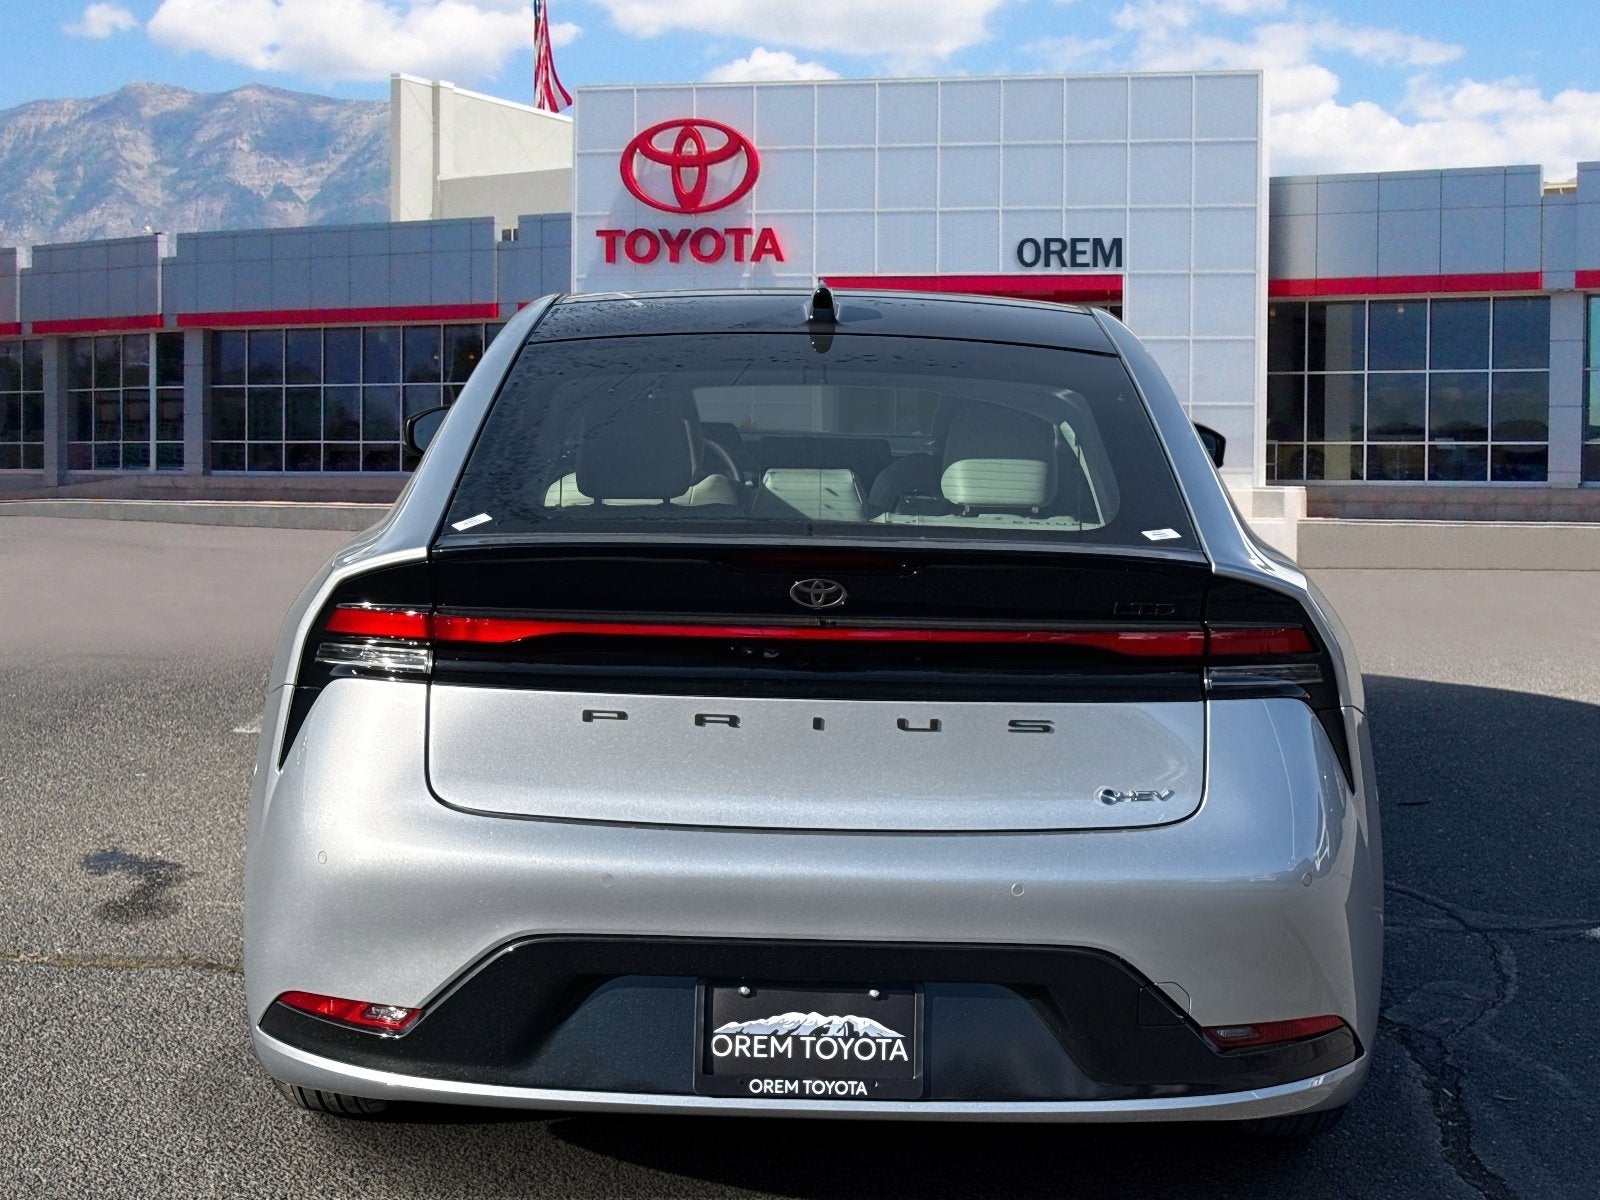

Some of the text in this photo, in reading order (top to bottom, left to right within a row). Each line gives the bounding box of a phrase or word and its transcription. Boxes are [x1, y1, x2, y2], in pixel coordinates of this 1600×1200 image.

[595, 227, 785, 264] TOYOTA
[1016, 237, 1123, 268] OREM
[582, 709, 1055, 733] PRIUS
[711, 1034, 909, 1062] OREM TOYOTA
[749, 1079, 868, 1096] OREM TOYOTA
